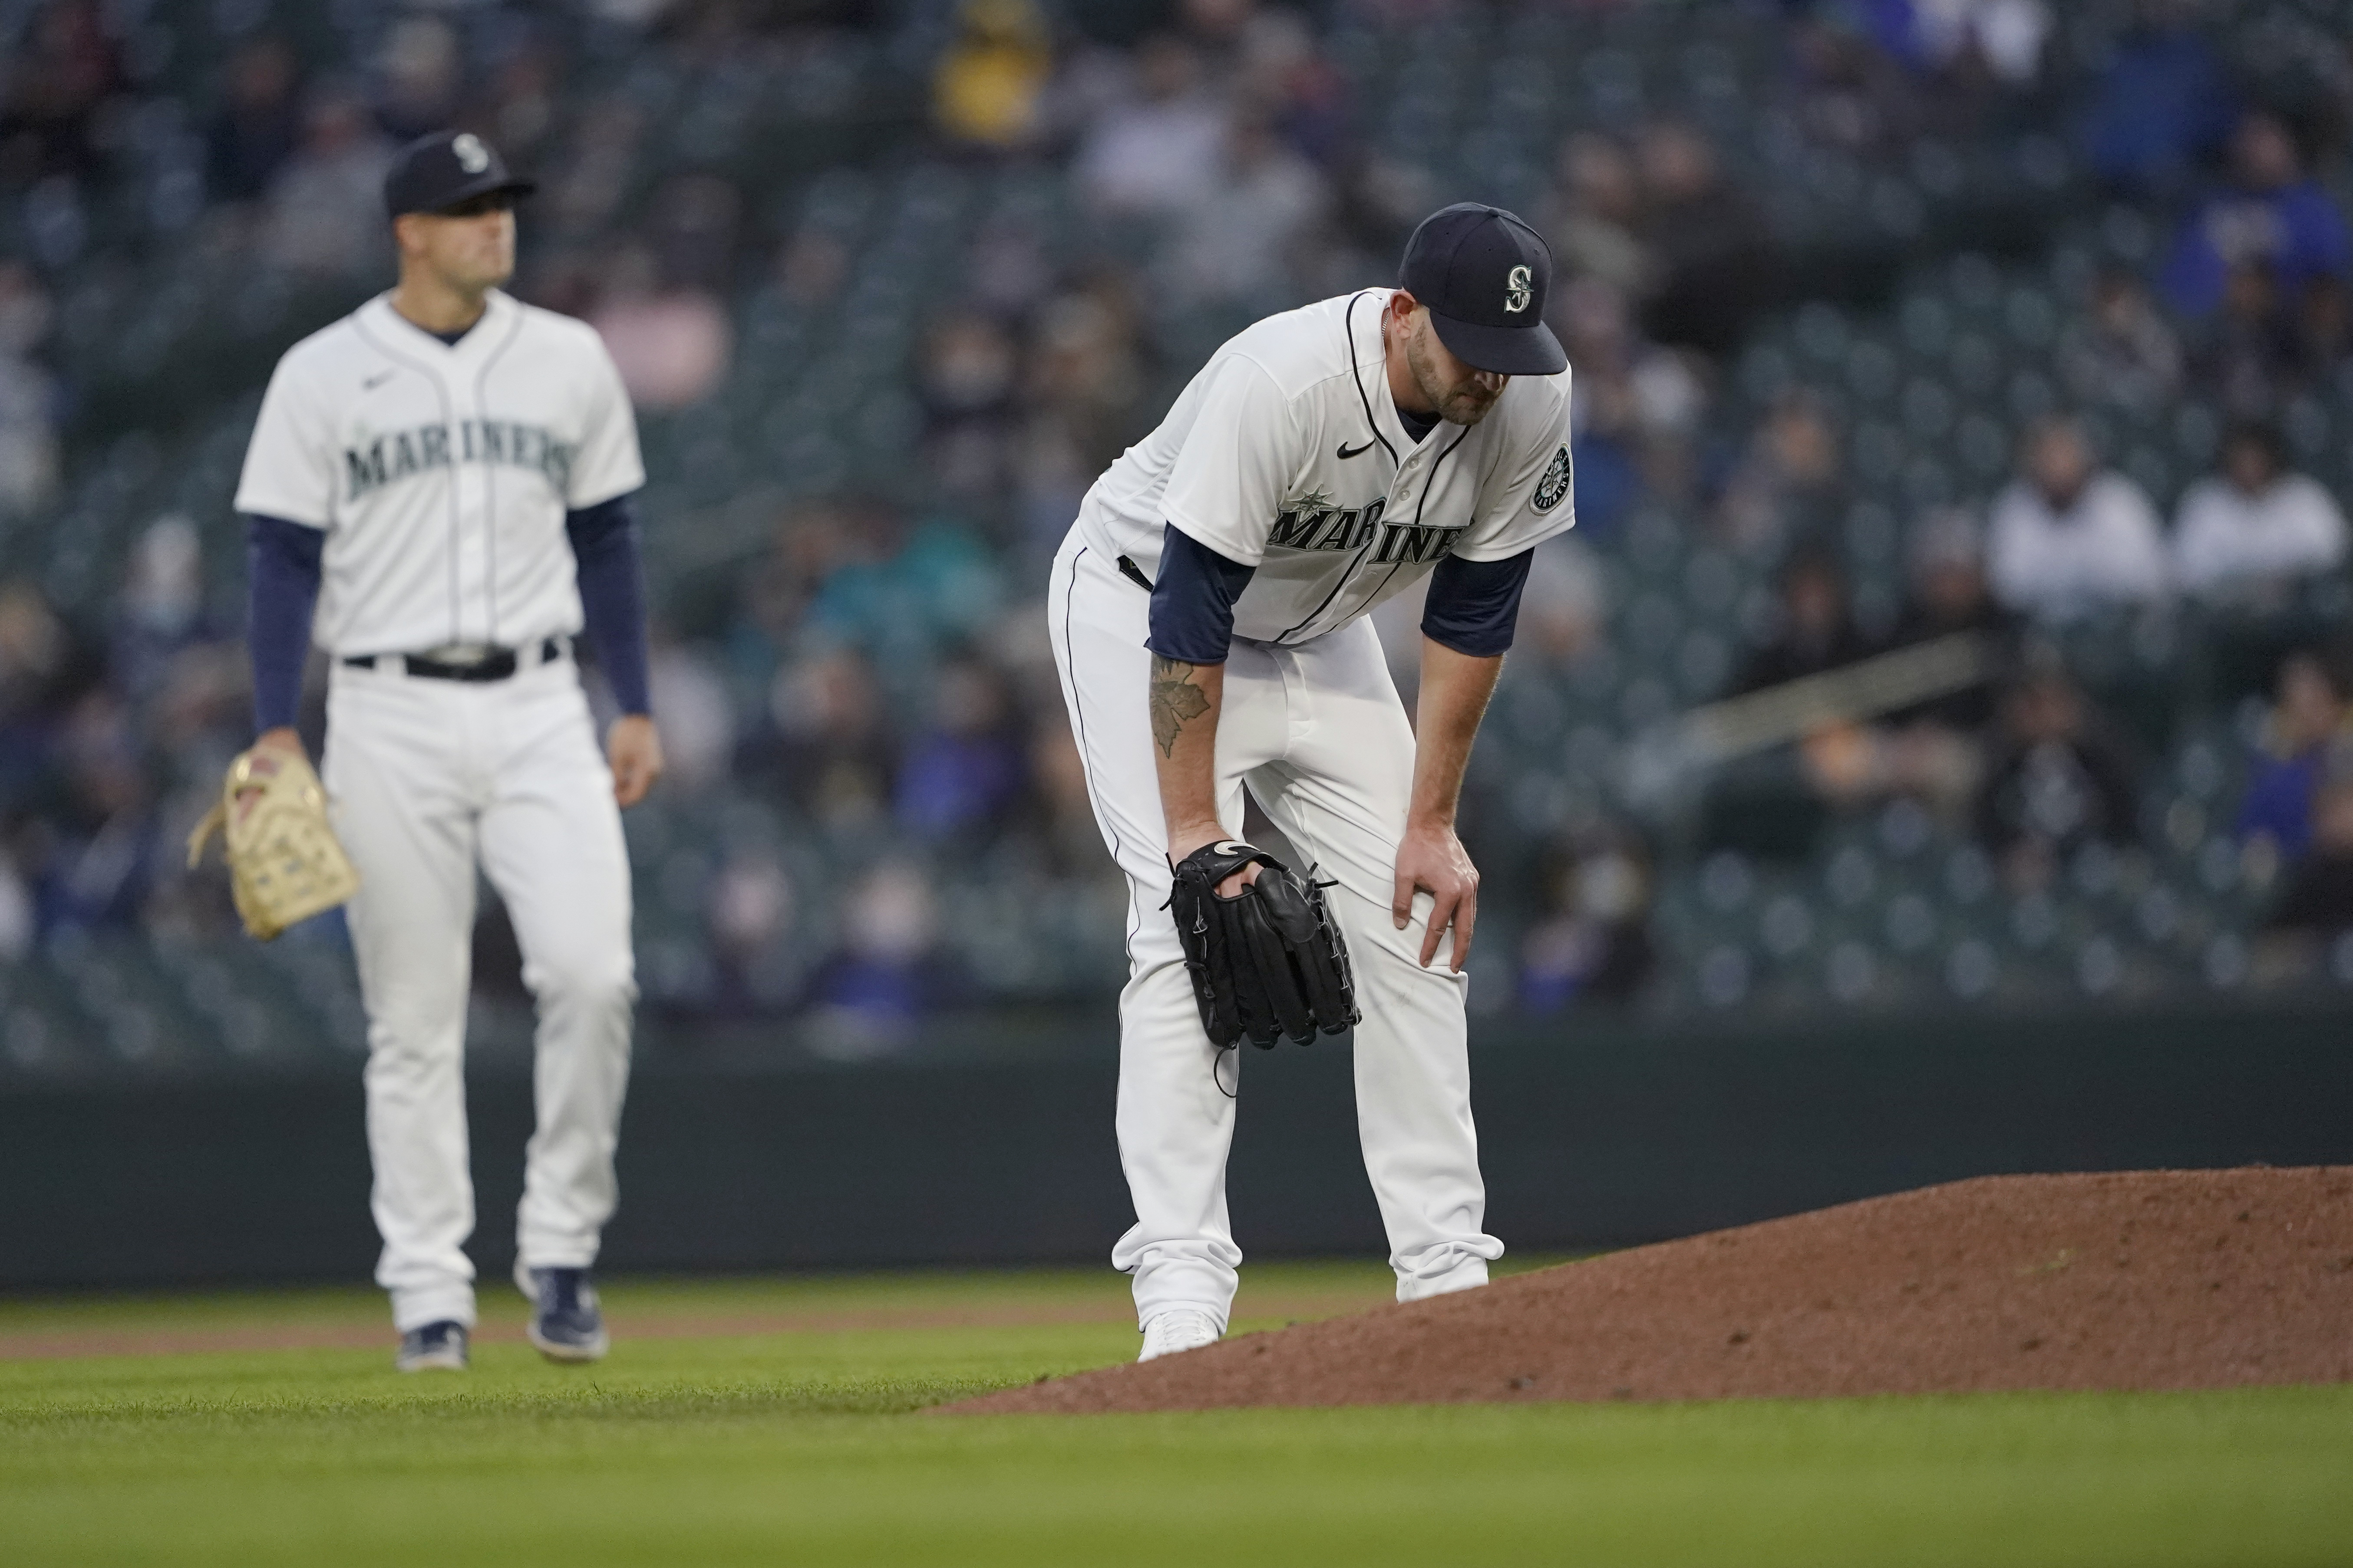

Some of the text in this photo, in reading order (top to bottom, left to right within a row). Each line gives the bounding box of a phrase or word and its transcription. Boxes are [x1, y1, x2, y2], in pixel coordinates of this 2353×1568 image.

[450, 133, 488, 173] S
[1504, 265, 1534, 313] S
[1535, 473, 1569, 507] MARINERS
[1266, 497, 1469, 564] MARINE
